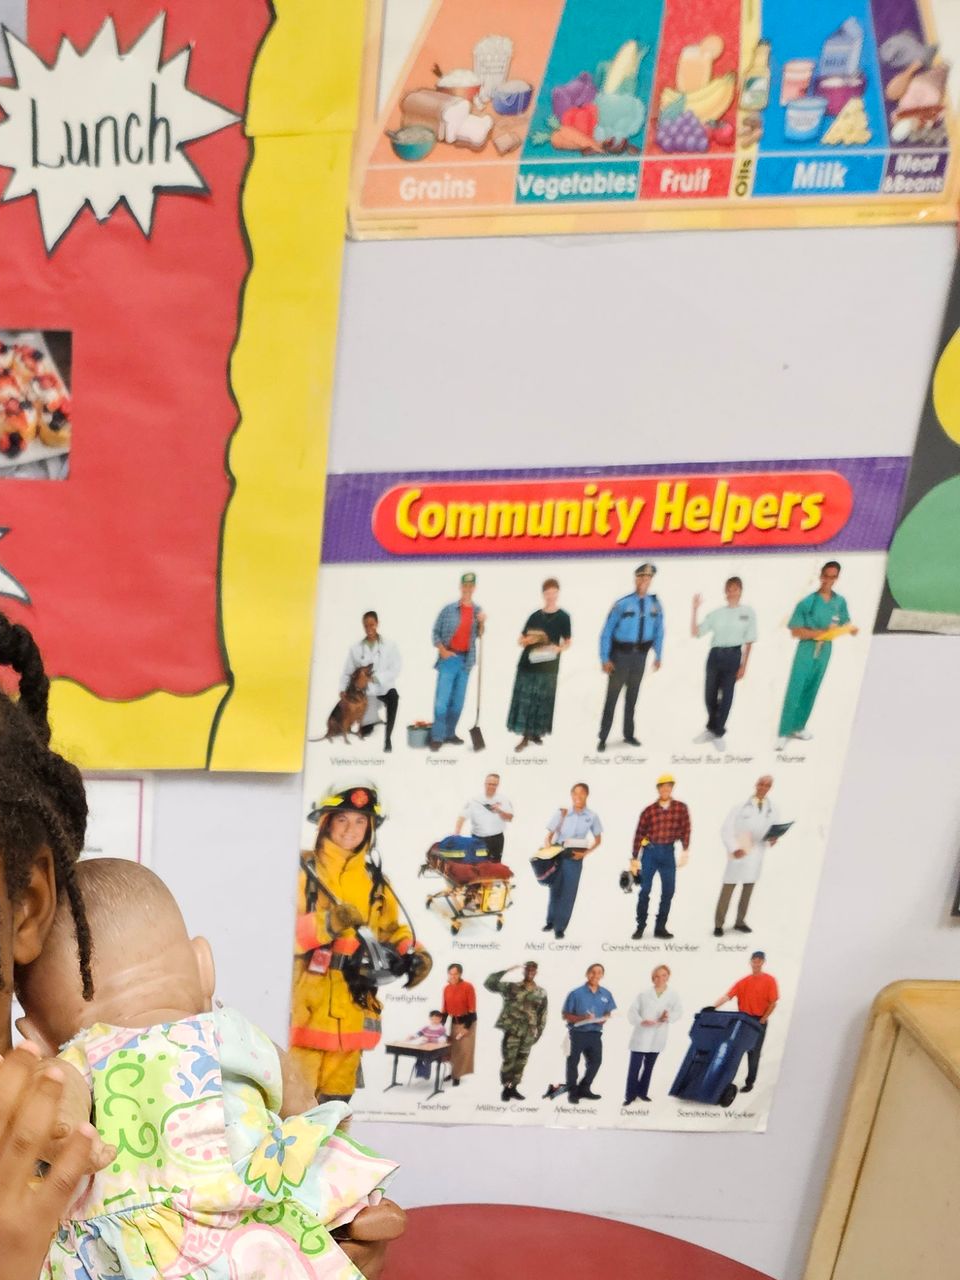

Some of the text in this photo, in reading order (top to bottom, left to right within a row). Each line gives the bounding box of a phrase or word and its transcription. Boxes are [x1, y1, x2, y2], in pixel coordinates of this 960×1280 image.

[31, 82, 171, 168] Lunch
[894, 153, 940, 173] Meat
[735, 160, 751, 197] Oils
[792, 160, 848, 190] Milk
[517, 170, 638, 201] Vegetables
[659, 167, 711, 194] Fruit
[398, 172, 477, 201] Grains
[396, 479, 825, 544] Community Helpers
[452, 941, 500, 950] Paramedic
[524, 942, 581, 952] Mail Carrier
[601, 942, 700, 952] Construction Worker
[716, 943, 748, 952] Doctor
[385, 994, 428, 1004] Firefighter
[417, 1102, 451, 1111] Teacher
[476, 1104, 539, 1113] Military Career
[554, 1106, 597, 1115] Mechanic
[620, 1108, 650, 1116] Dentist
[677, 1109, 720, 1118] Sanitation
